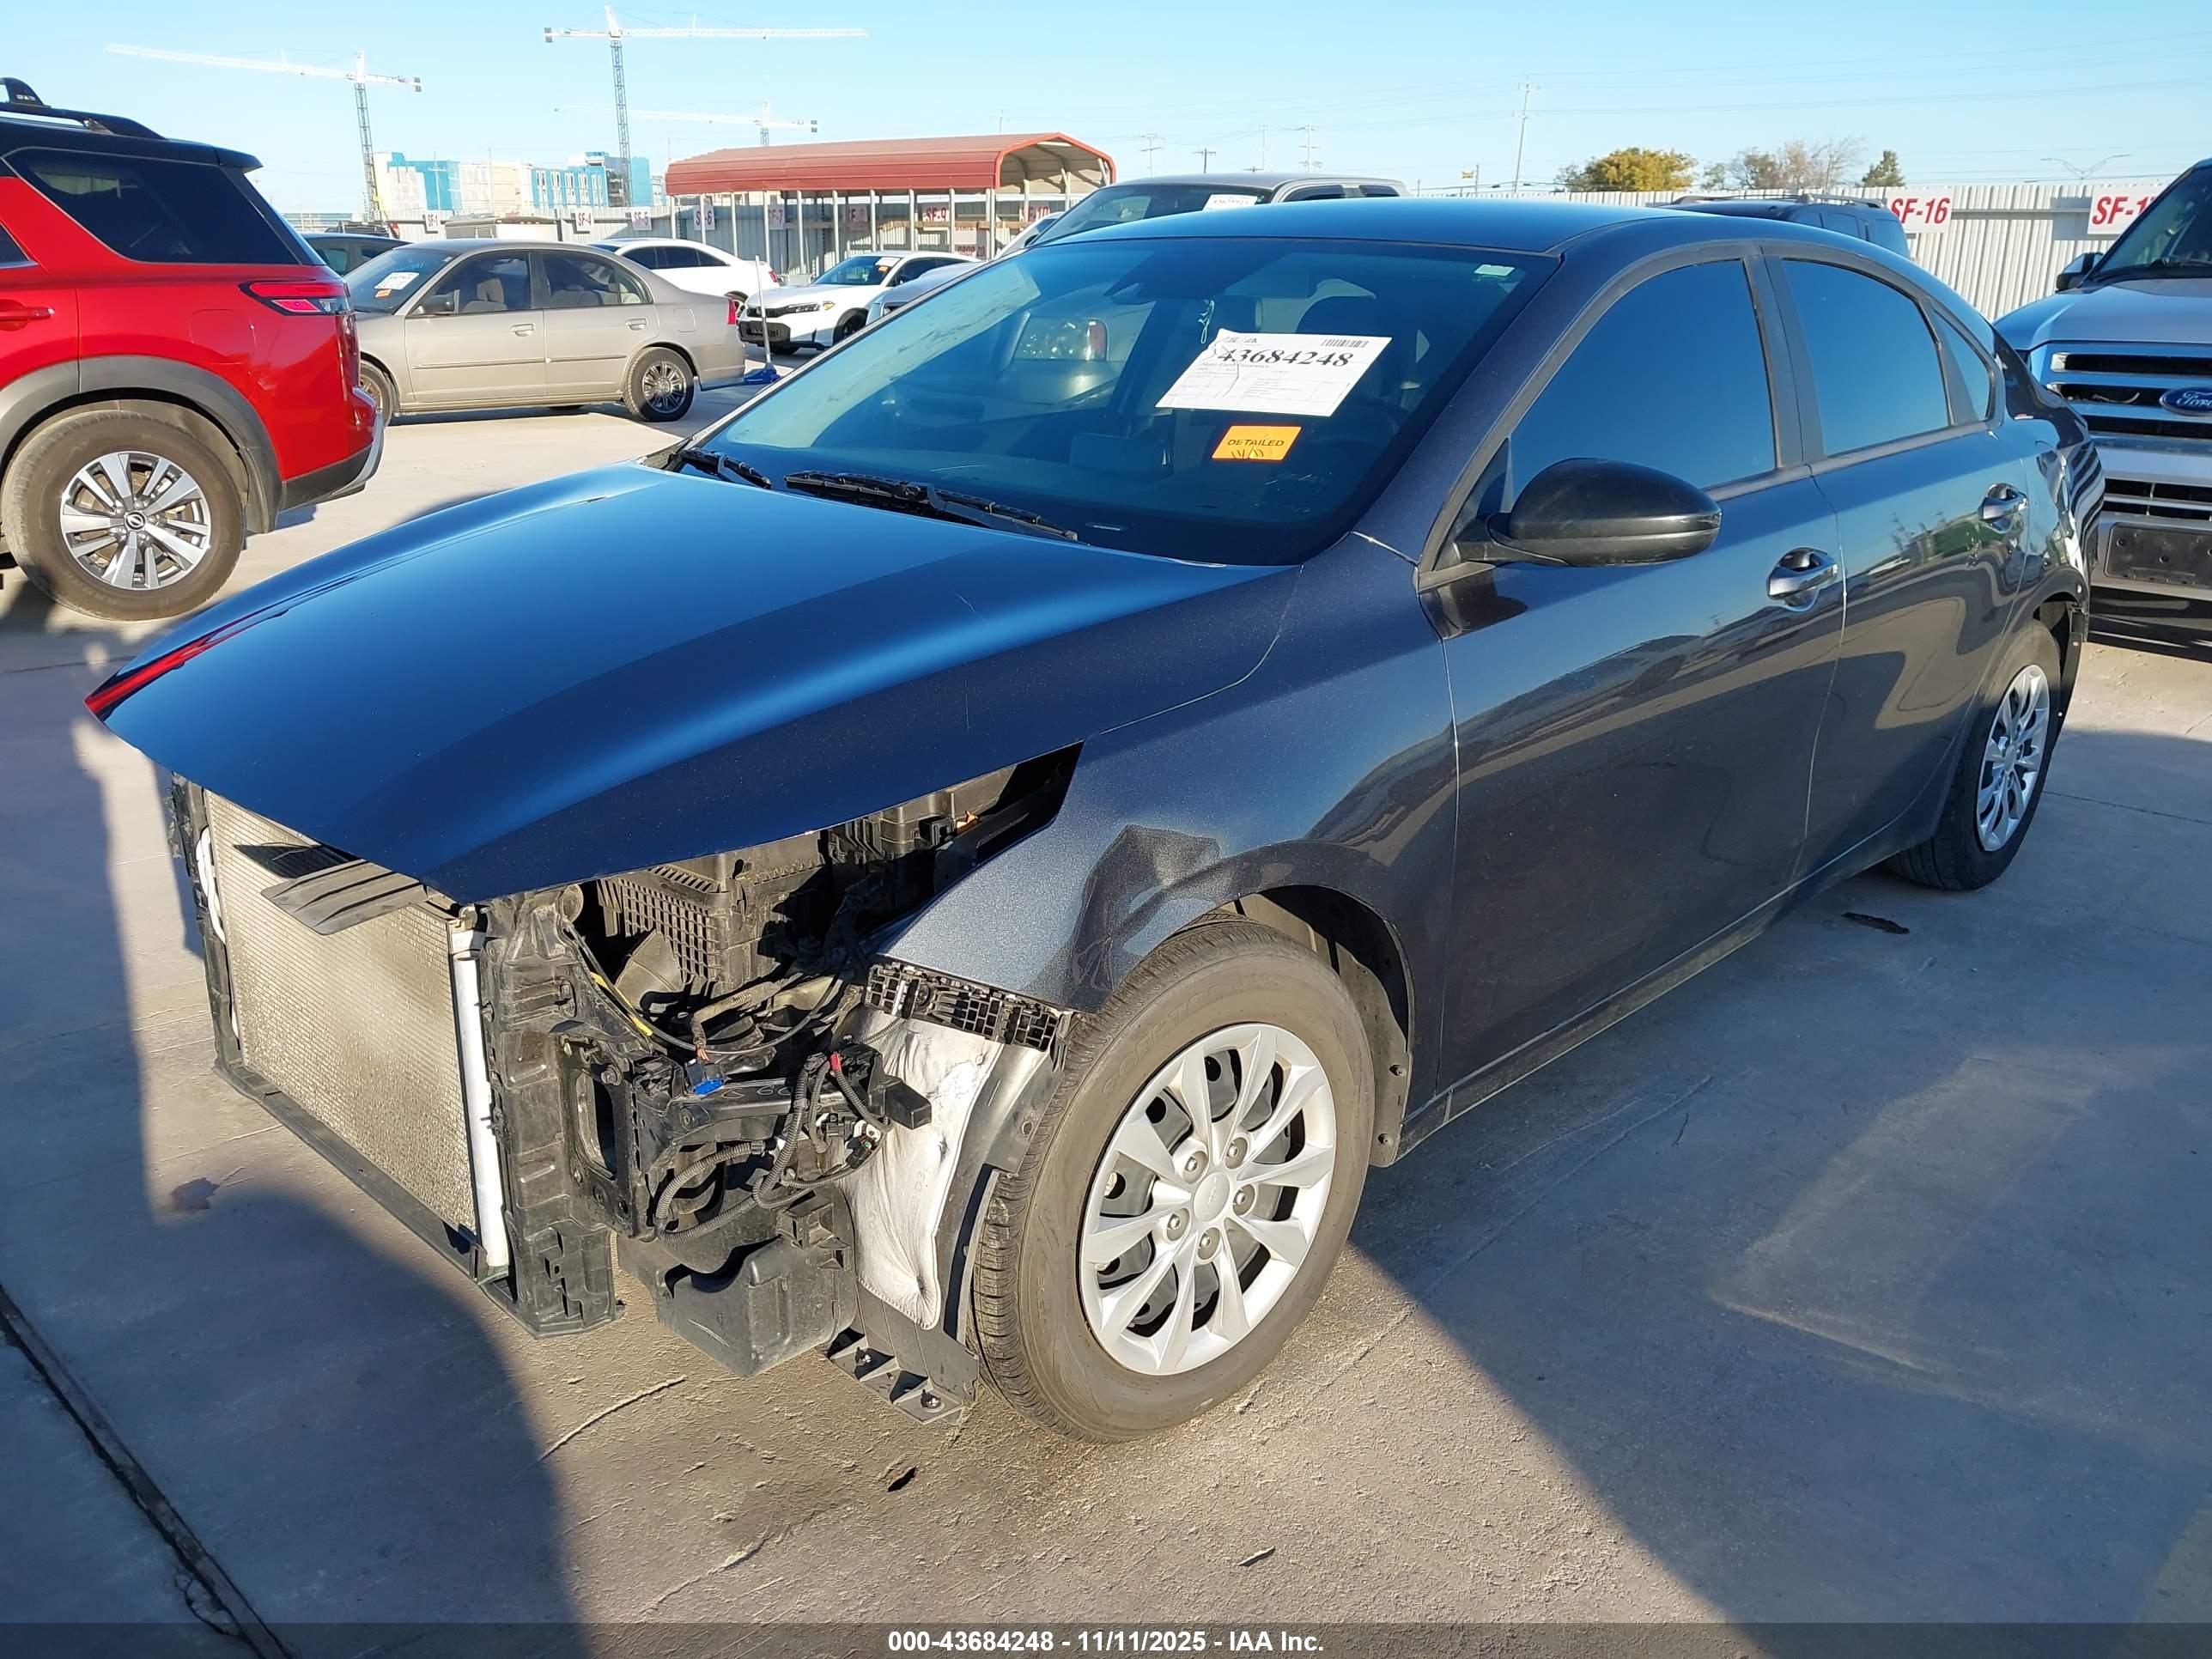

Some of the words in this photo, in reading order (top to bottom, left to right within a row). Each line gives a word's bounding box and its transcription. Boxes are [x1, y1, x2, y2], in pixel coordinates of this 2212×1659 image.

[577, 212, 592, 227] SF-4
[696, 210, 713, 226] S-6
[1891, 198, 1951, 224] SF-16
[2092, 196, 2157, 225] SF-1
[1217, 349, 1354, 368] 43684248
